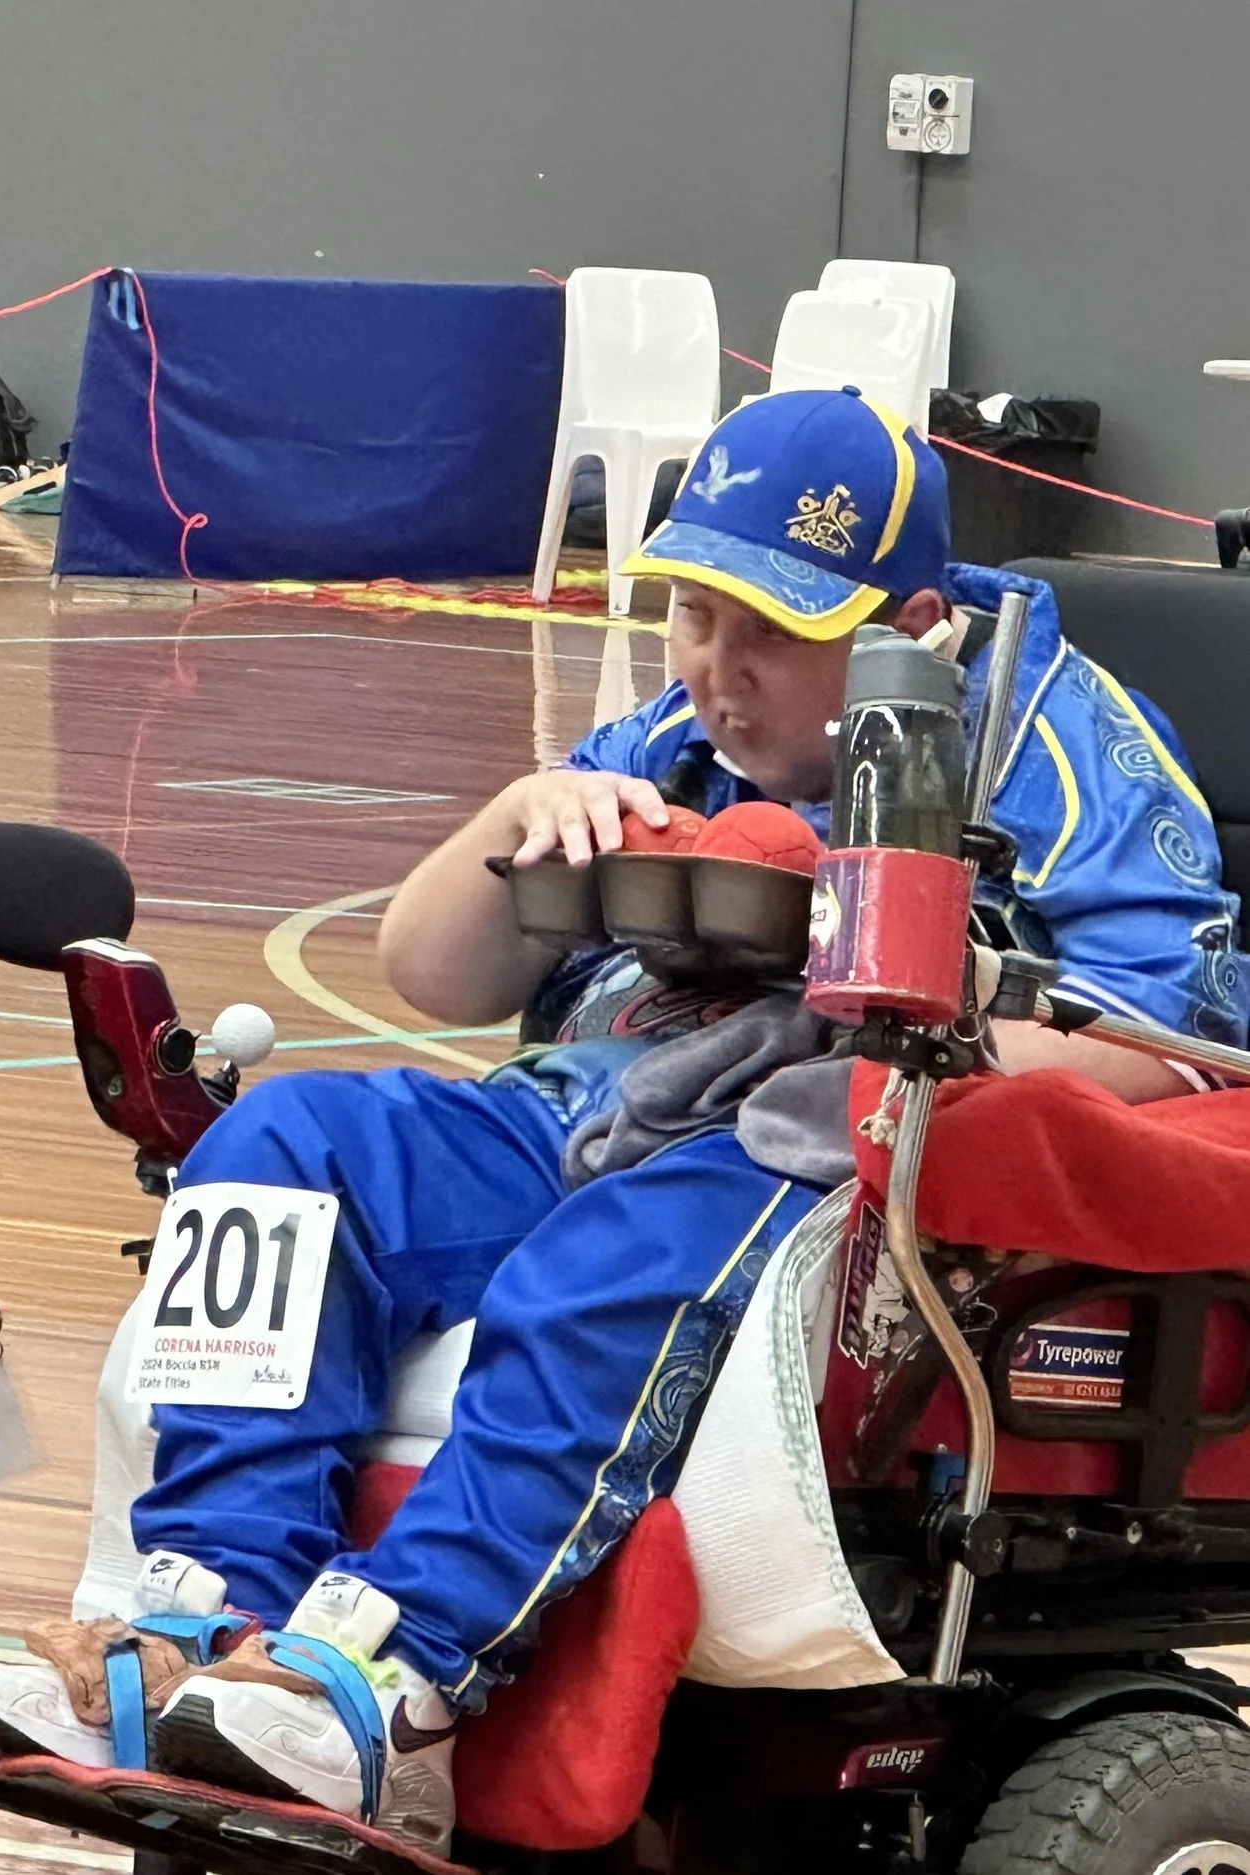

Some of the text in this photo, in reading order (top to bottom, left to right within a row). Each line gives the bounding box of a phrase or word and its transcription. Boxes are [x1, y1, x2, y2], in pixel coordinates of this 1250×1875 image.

[154, 1207, 302, 1331] 201
[155, 1338, 276, 1357] CORENA HARRISON
[1037, 1339, 1124, 1368] Tyrepower
[166, 1358, 197, 1371] Boccia
[866, 1746, 925, 1773] edge
